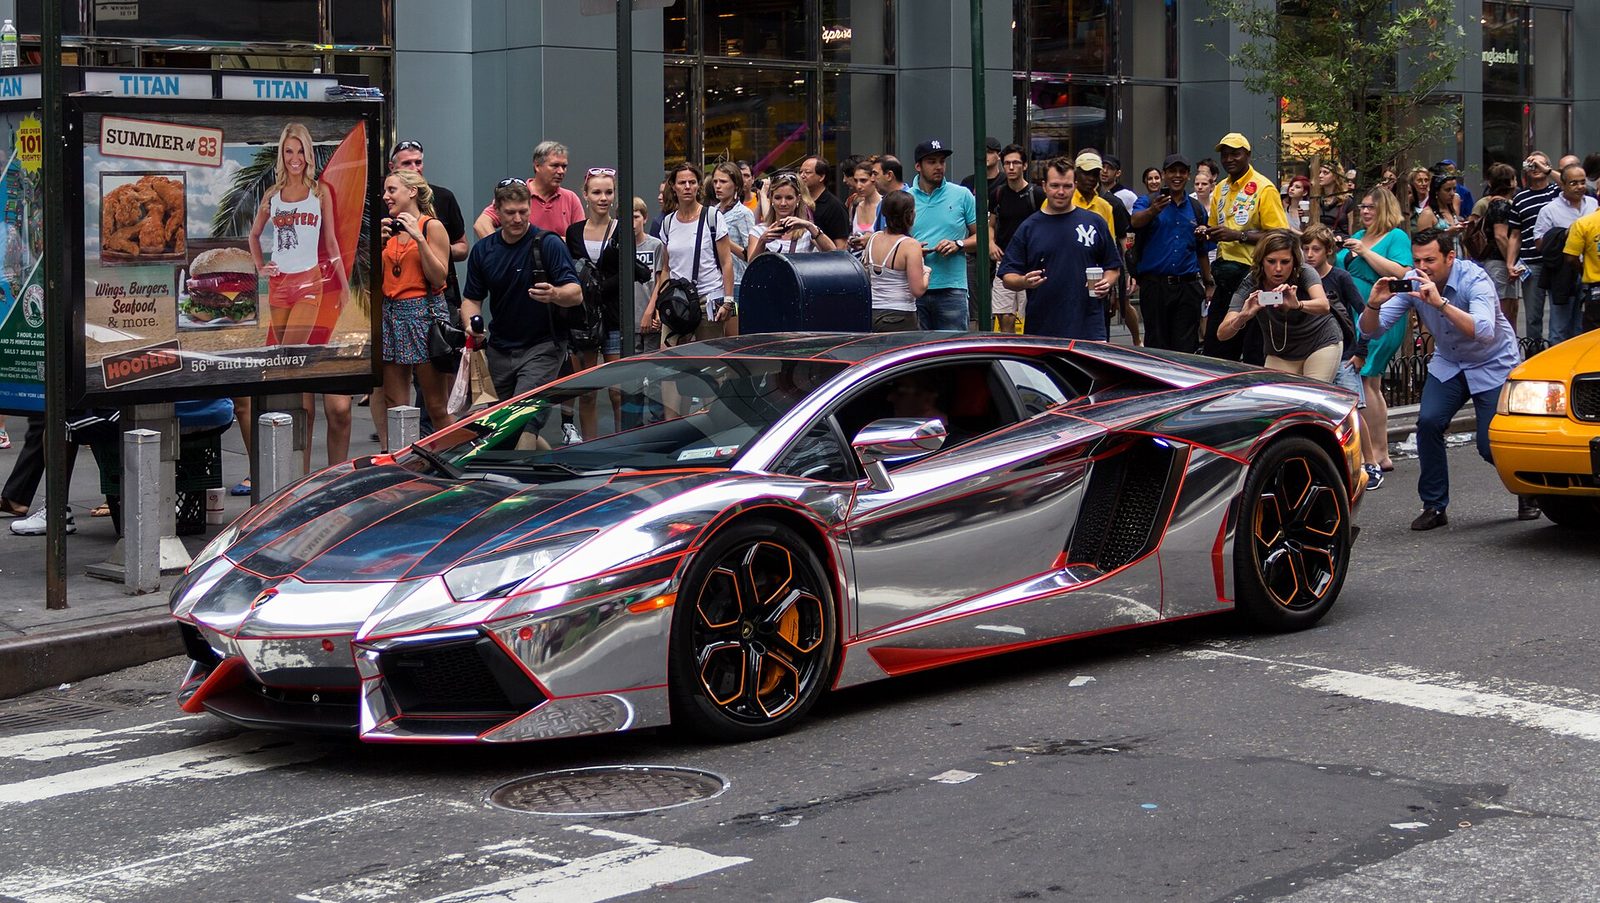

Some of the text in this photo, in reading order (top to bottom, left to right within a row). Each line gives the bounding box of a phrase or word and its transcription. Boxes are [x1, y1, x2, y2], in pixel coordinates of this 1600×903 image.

[119, 75, 180, 96] TITAN
[253, 79, 308, 99] TITAN
[20, 135, 42, 153] 101
[106, 128, 217, 157] SUMMER of 83
[1075, 224, 1097, 247] NY
[95, 281, 169, 299] Wings, Burgers,
[112, 299, 157, 315] Seafood,
[107, 316, 159, 328] & more.
[106, 351, 177, 380] HOOTERS
[217, 359, 241, 371] and
[245, 353, 307, 369] Broadway
